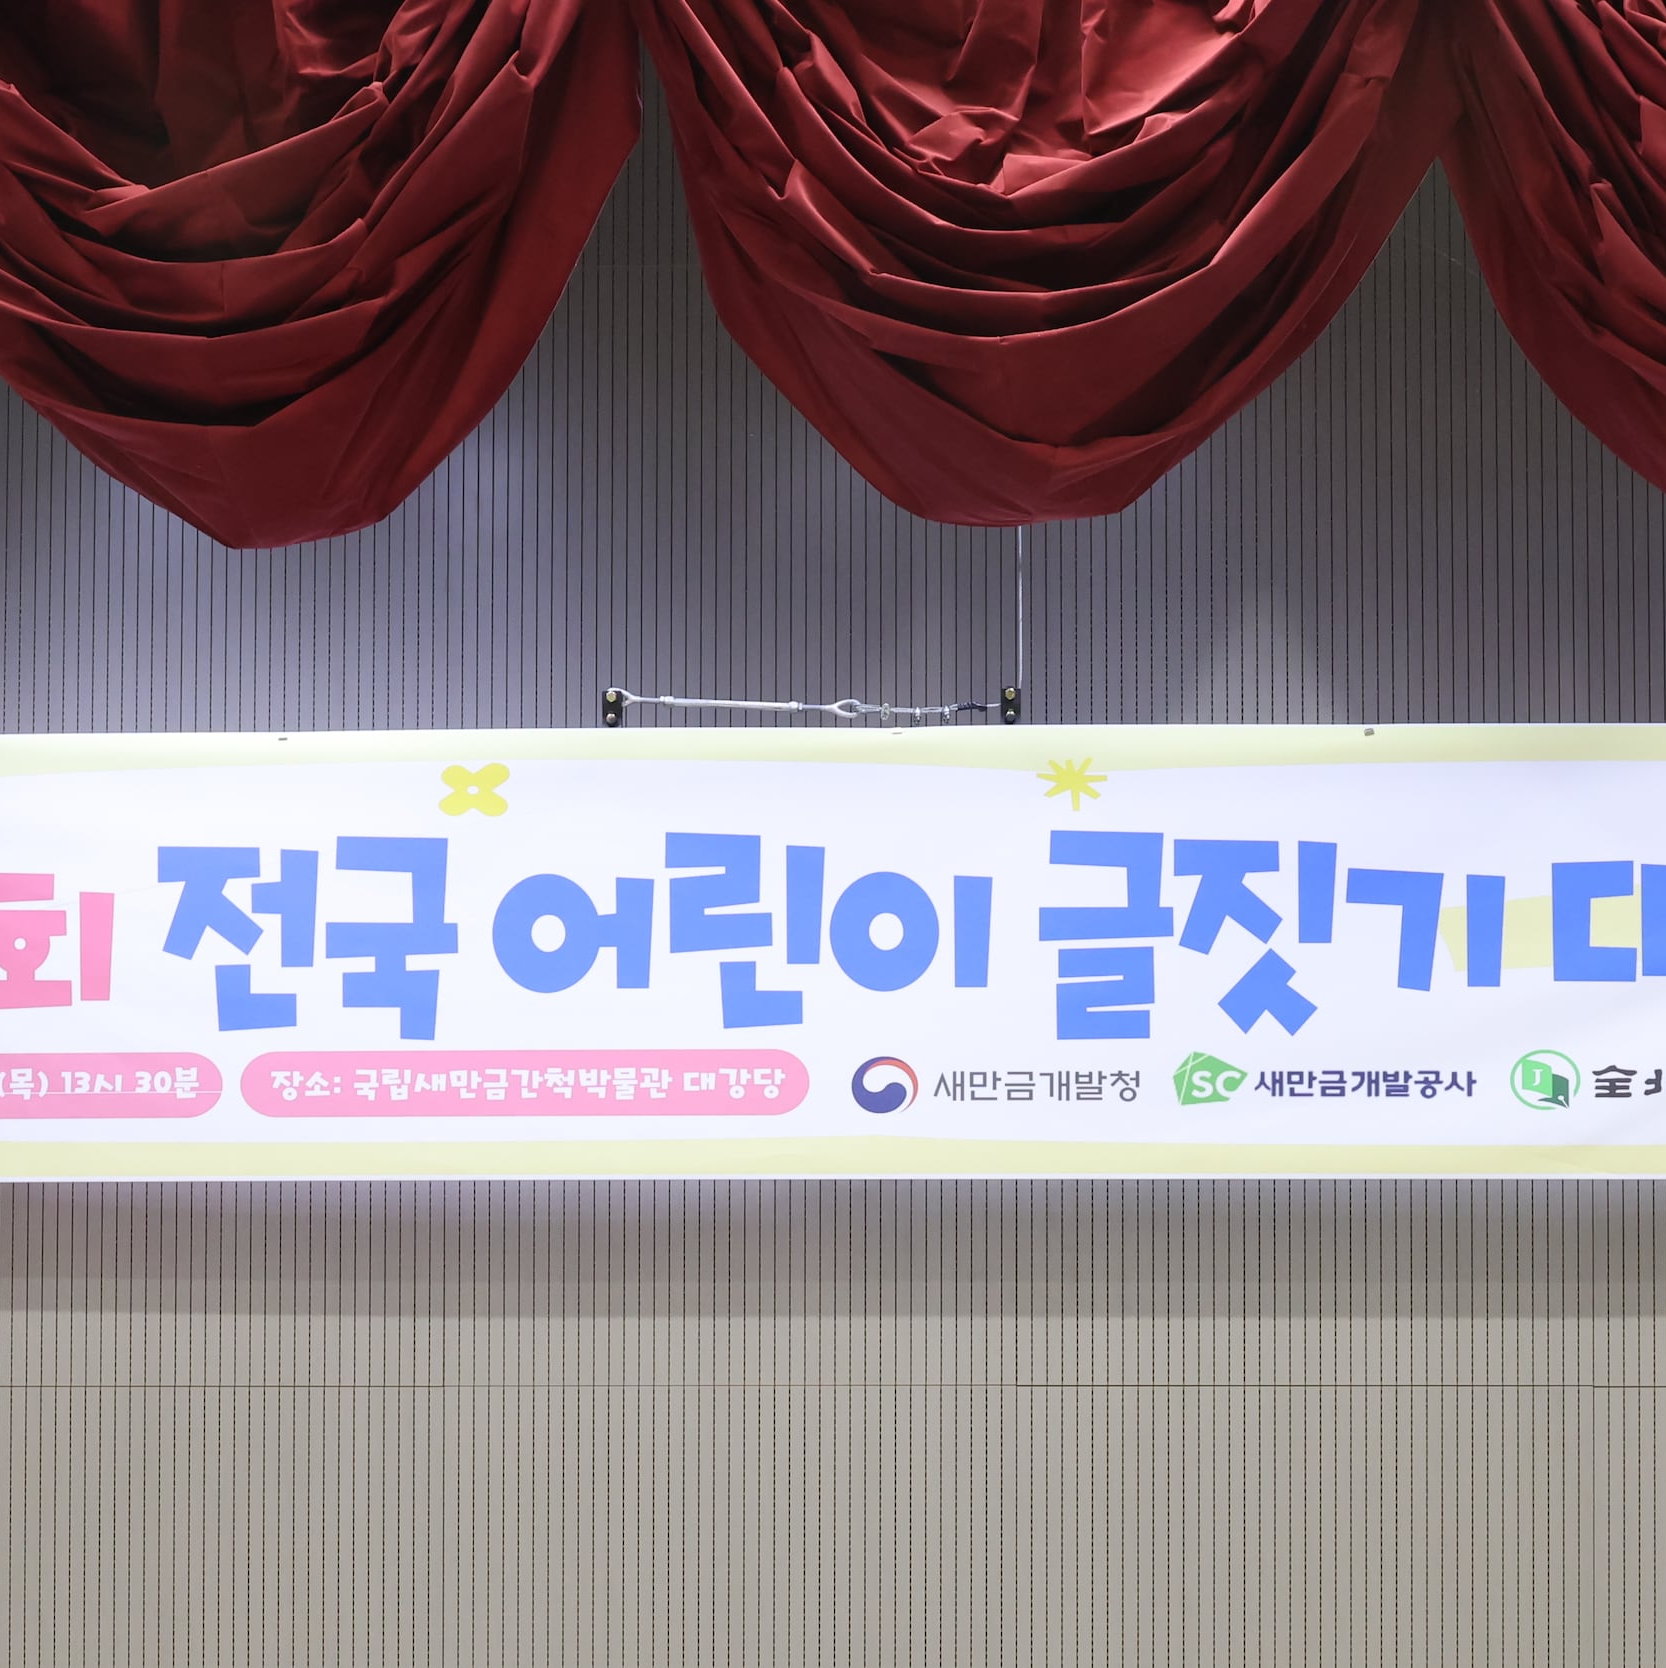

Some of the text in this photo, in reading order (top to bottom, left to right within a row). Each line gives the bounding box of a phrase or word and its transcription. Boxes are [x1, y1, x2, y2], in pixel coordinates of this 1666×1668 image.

[159, 837, 458, 1041] 전국
[493, 832, 993, 1029] 어린이
[1040, 831, 1506, 1041] 글짓기
[61, 1071, 123, 1095] 13시
[135, 1067, 199, 1099] 30분
[270, 1068, 786, 1101] 장소: 국립새만금간척박물관 대강당
[933, 1070, 1140, 1102] 새만금개발청
[1254, 1070, 1477, 1099] 새만금개발공사
